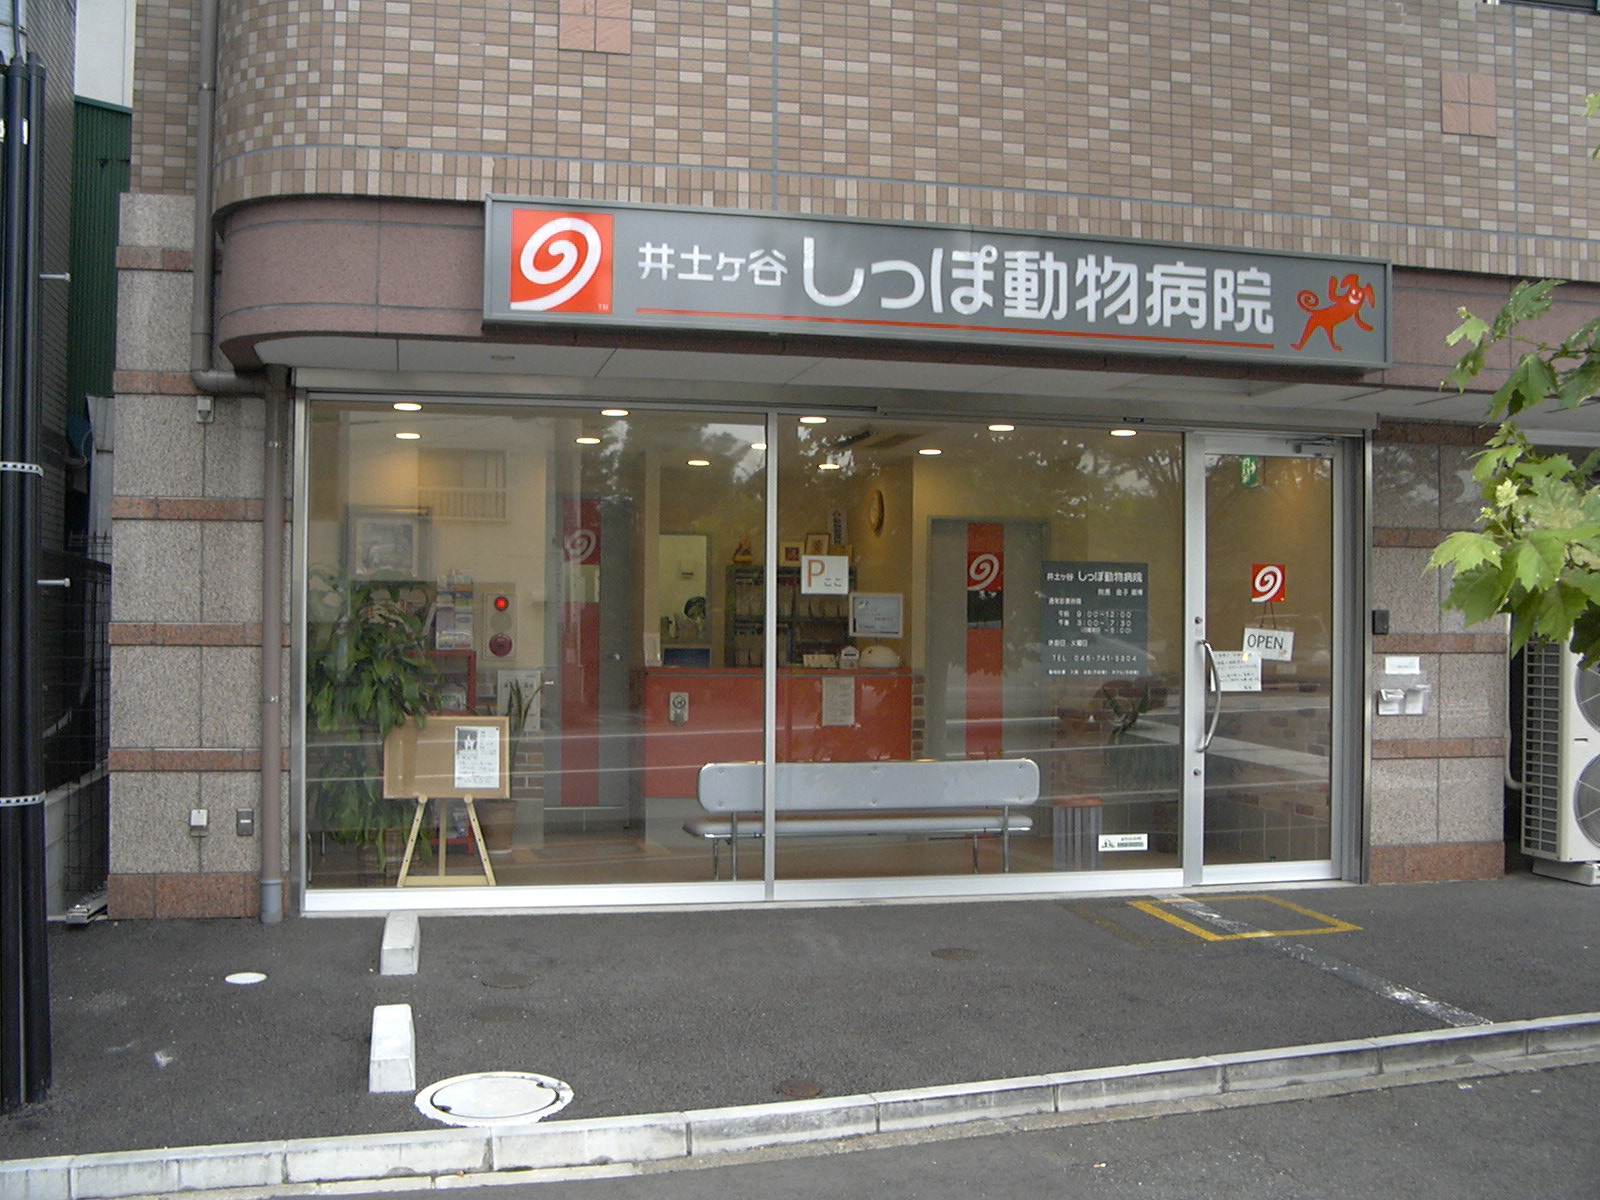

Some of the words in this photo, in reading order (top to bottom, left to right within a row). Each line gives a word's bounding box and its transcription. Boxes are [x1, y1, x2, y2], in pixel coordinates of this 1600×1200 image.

[802, 236, 1275, 335] しっぽ動物病院
[807, 559, 826, 588] P
[1247, 633, 1284, 649] OPEN
[1052, 654, 1067, 662] TEL
